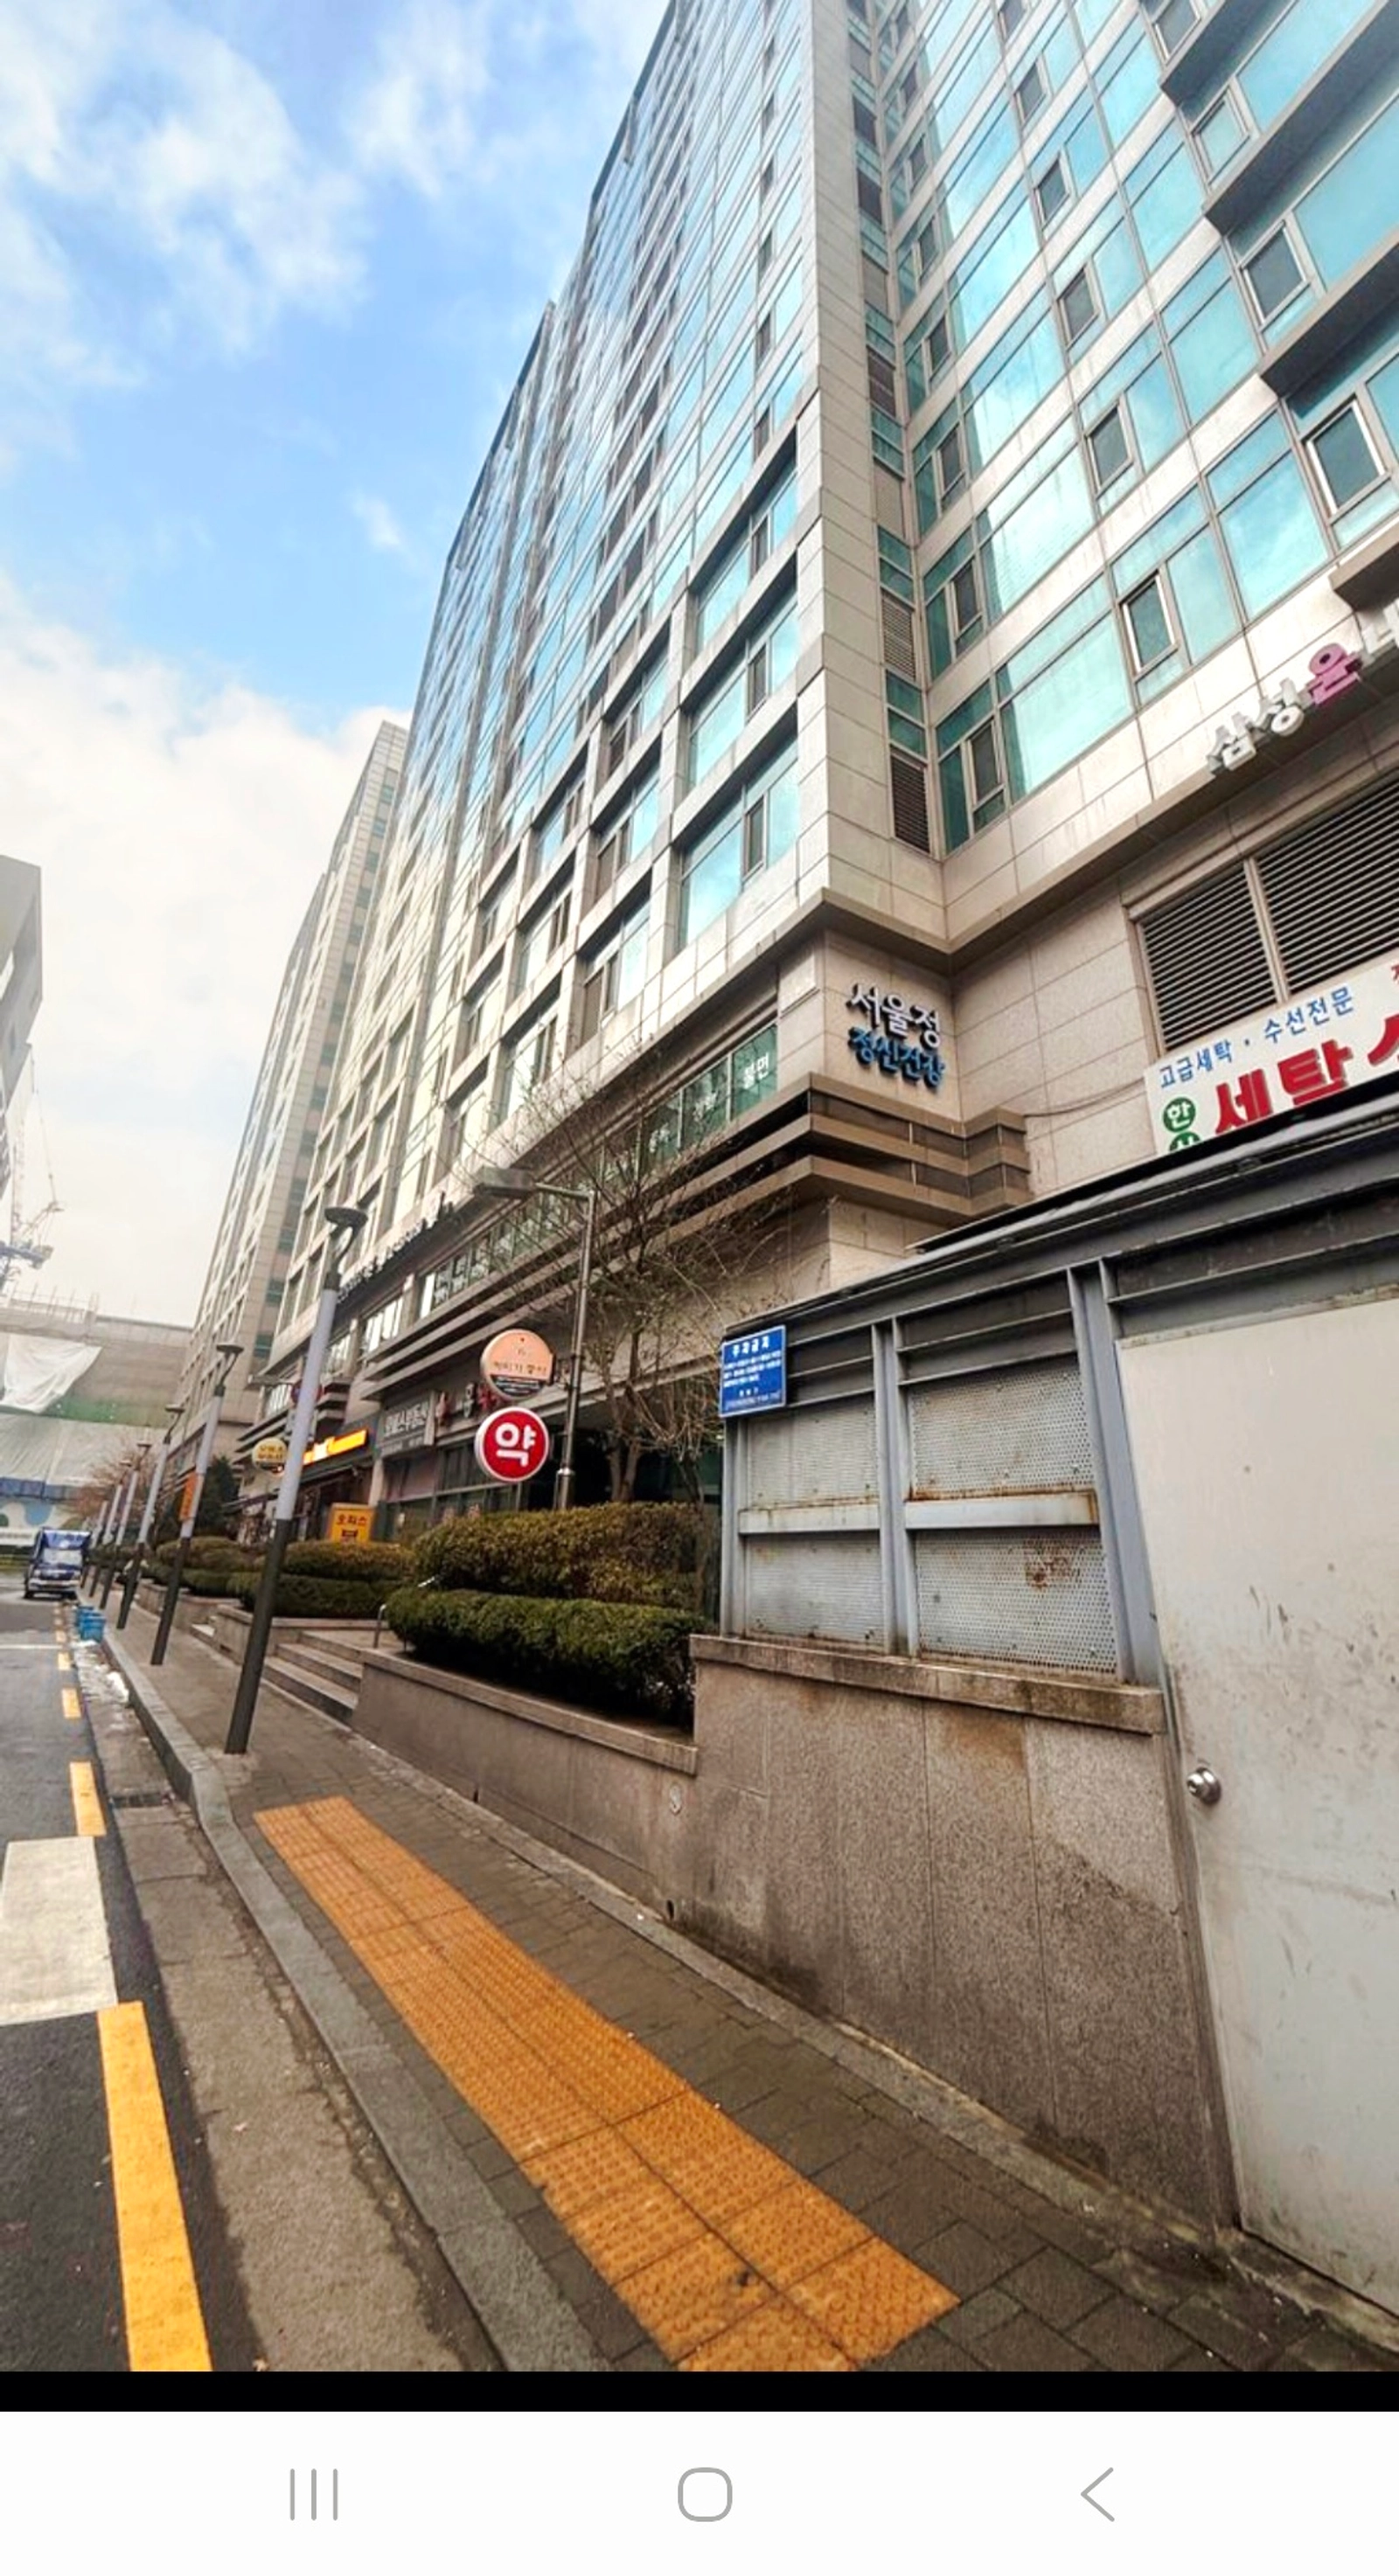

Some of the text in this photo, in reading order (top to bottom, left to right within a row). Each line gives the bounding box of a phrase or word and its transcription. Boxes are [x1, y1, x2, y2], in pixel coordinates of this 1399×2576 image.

[846, 983, 941, 1049] 서울정
[1159, 985, 1354, 1088] 고급세탁 수선전문
[495, 1421, 537, 1468] 약
